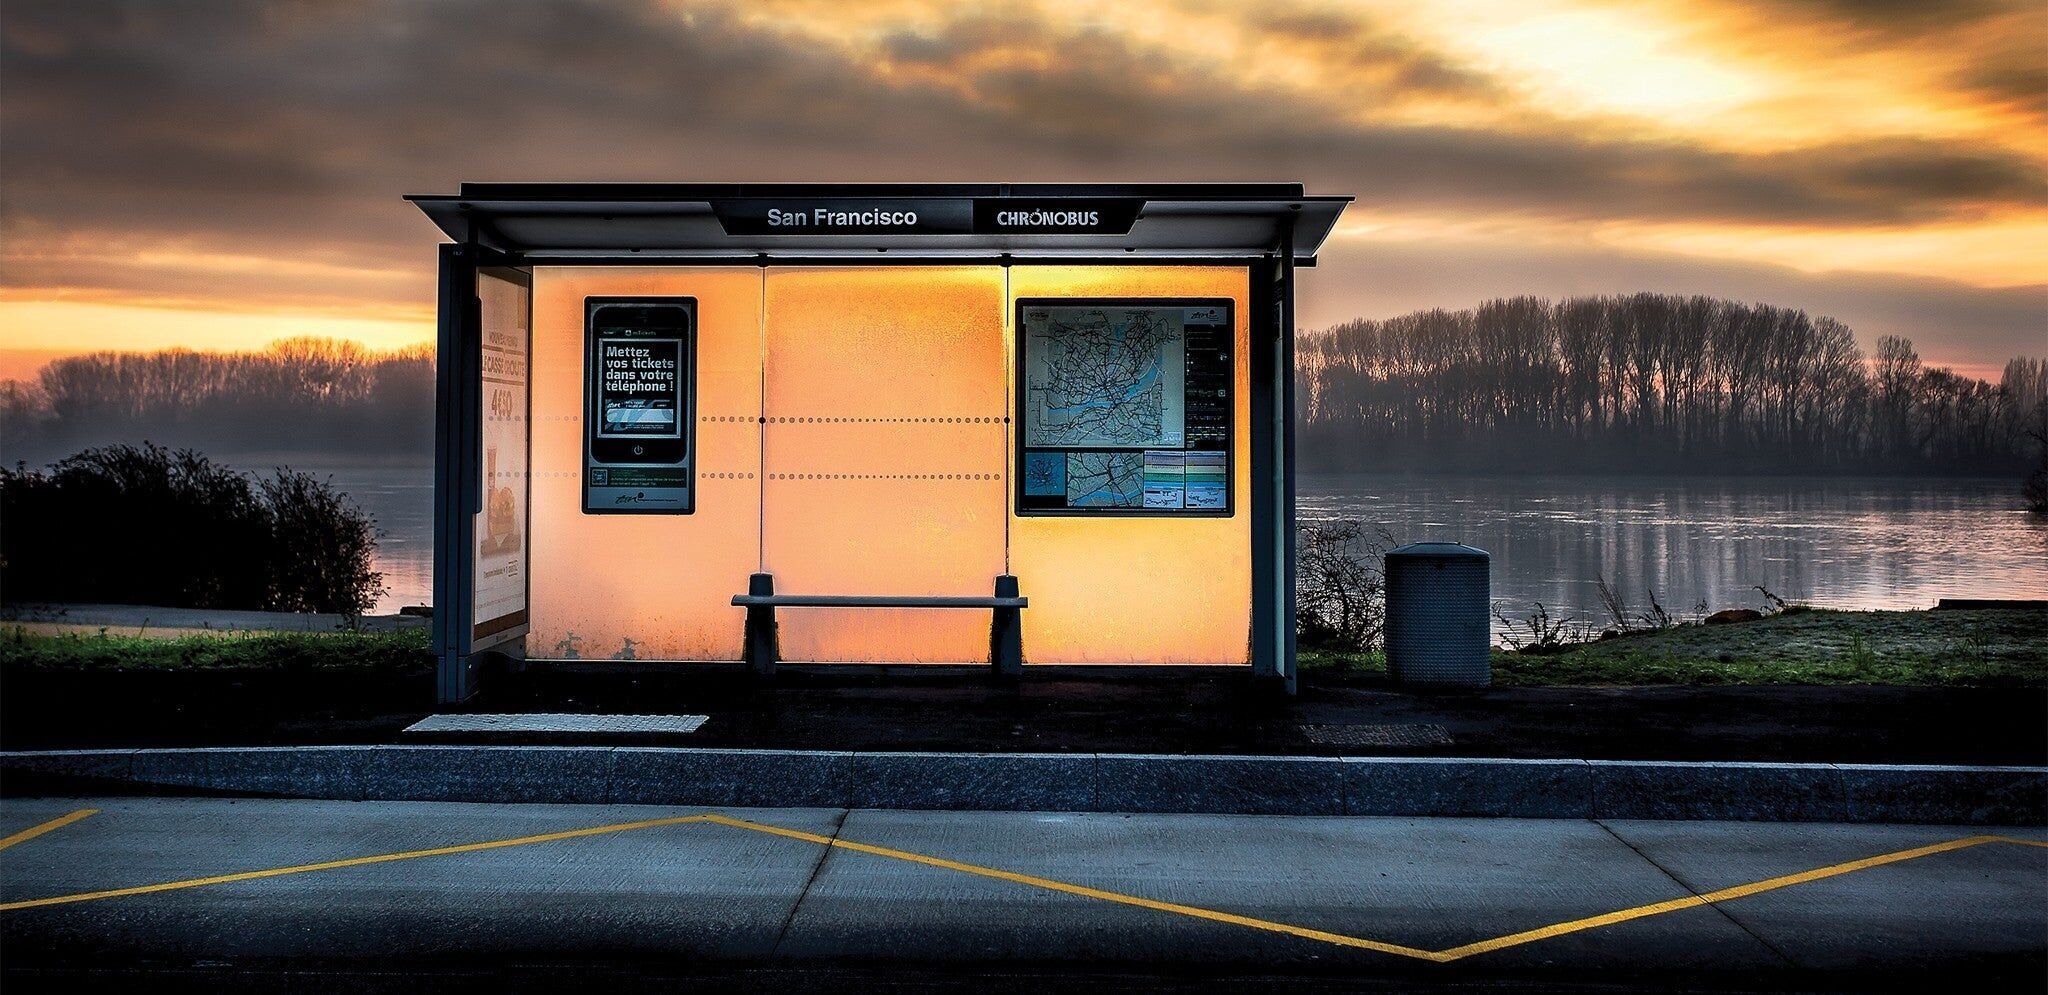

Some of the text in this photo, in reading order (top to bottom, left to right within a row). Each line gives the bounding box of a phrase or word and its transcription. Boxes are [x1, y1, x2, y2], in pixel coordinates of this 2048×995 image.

[768, 208, 917, 225] San Francisco
[997, 208, 1098, 225] CHRONOBUS
[607, 346, 649, 357] Mettez
[607, 358, 674, 368] vos tickets
[606, 368, 674, 379] dans votre
[606, 380, 666, 394] téléphone
